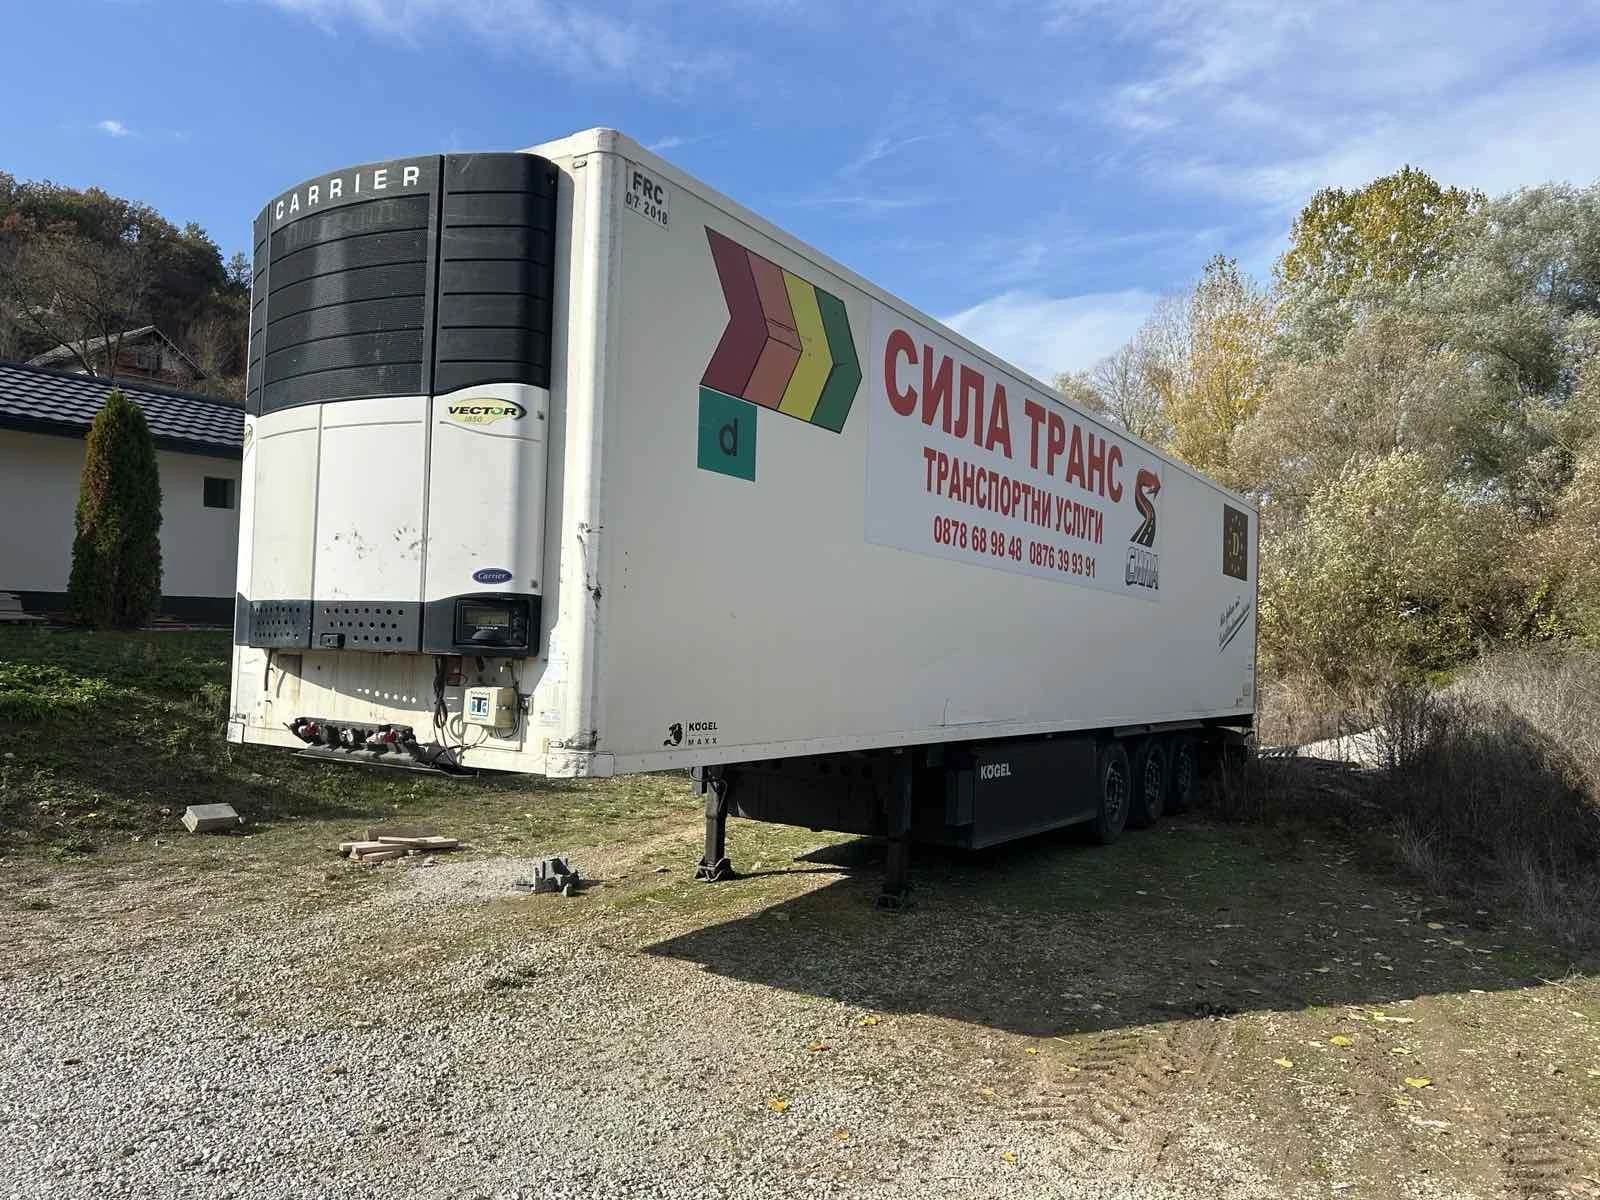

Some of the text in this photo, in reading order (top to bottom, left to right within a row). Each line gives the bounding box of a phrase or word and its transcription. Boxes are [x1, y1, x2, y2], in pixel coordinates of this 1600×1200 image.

[275, 166, 420, 221] CARRIER
[633, 171, 664, 205] FRC
[448, 406, 518, 416] VECTOR
[884, 328, 1124, 504] СИЛА ТРАНС
[719, 417, 738, 457] d
[923, 446, 1104, 545] ТРАНСПОРТНИ УСЛУГИ
[933, 515, 1097, 579] 0878 68 98 48 0876 39 93 91
[477, 572, 508, 580] Carrier
[688, 737, 718, 746] MAXX
